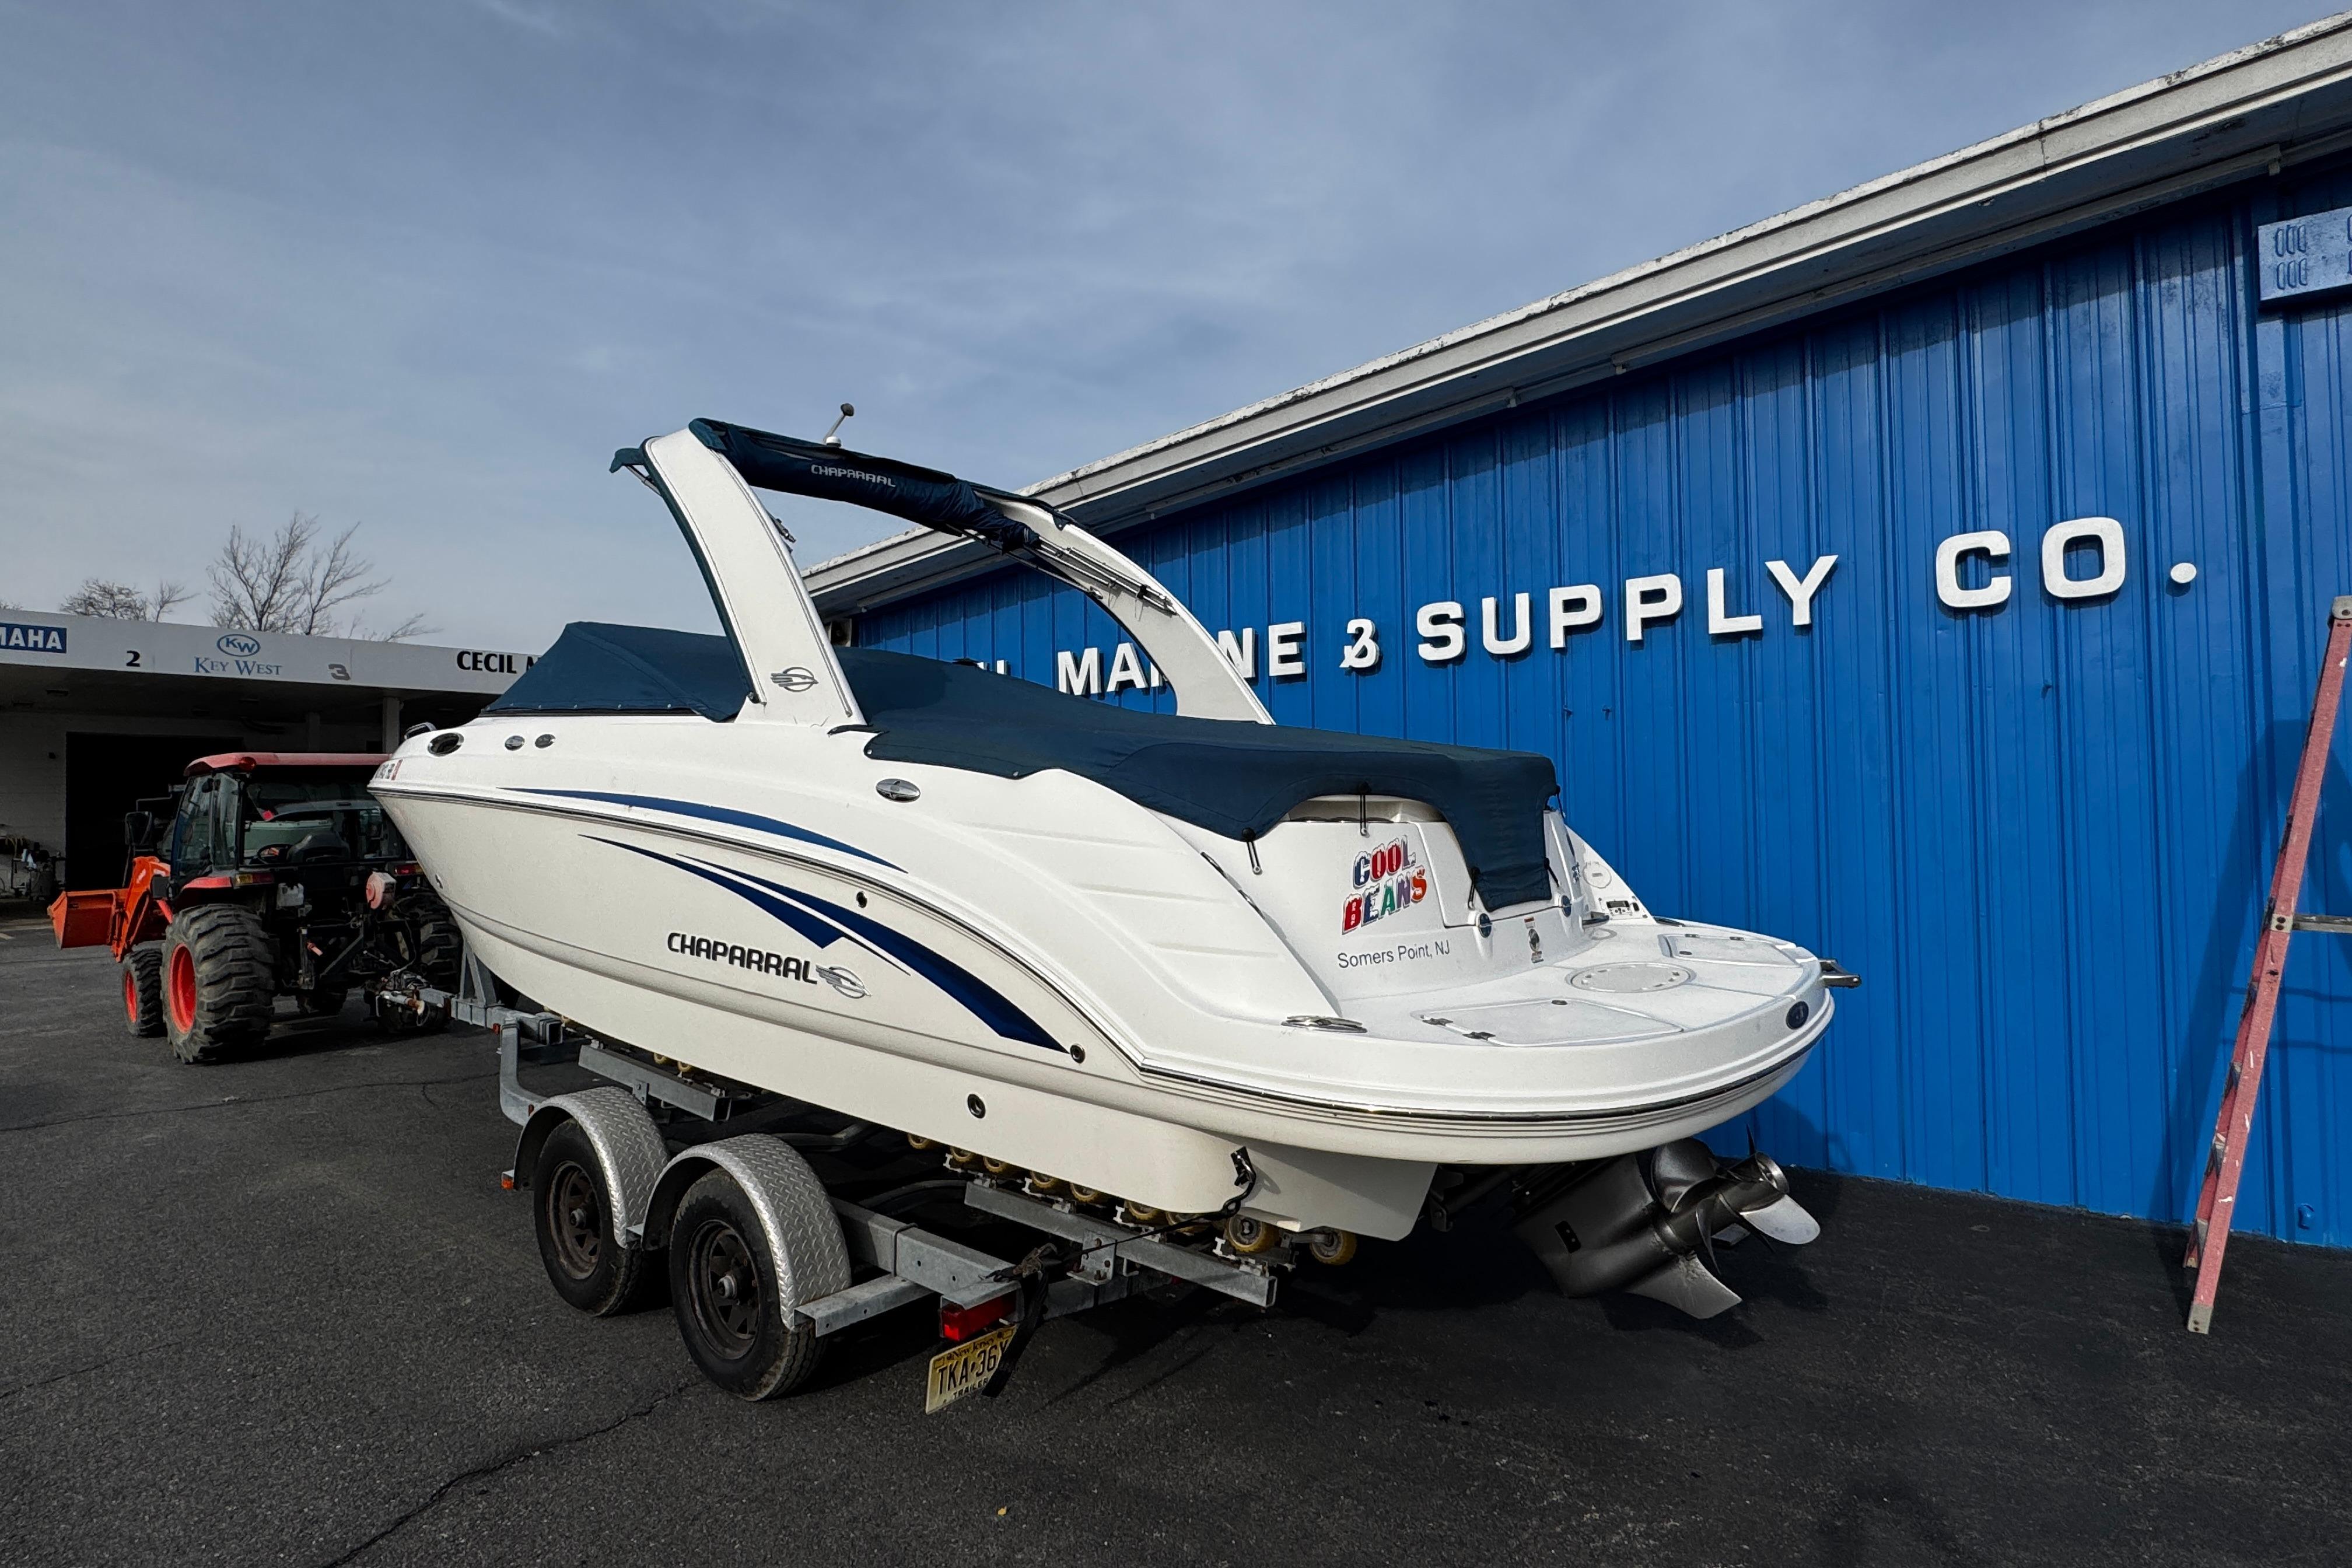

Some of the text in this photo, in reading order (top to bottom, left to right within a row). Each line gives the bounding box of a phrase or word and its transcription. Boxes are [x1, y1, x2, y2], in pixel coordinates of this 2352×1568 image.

[811, 465, 896, 487] CHAPARRAL
[1058, 621, 1306, 695] MANE
[1417, 554, 1839, 660] SUPPLY
[1936, 517, 2197, 608] CO.
[126, 650, 141, 667] 2
[328, 663, 351, 680] 3
[457, 651, 517, 674] CECIL
[1353, 835, 1416, 890] COOL
[1342, 865, 1427, 935] BEANS
[667, 932, 818, 985] CHAPARRAL
[1338, 939, 1450, 969] Somers Point, NJ
